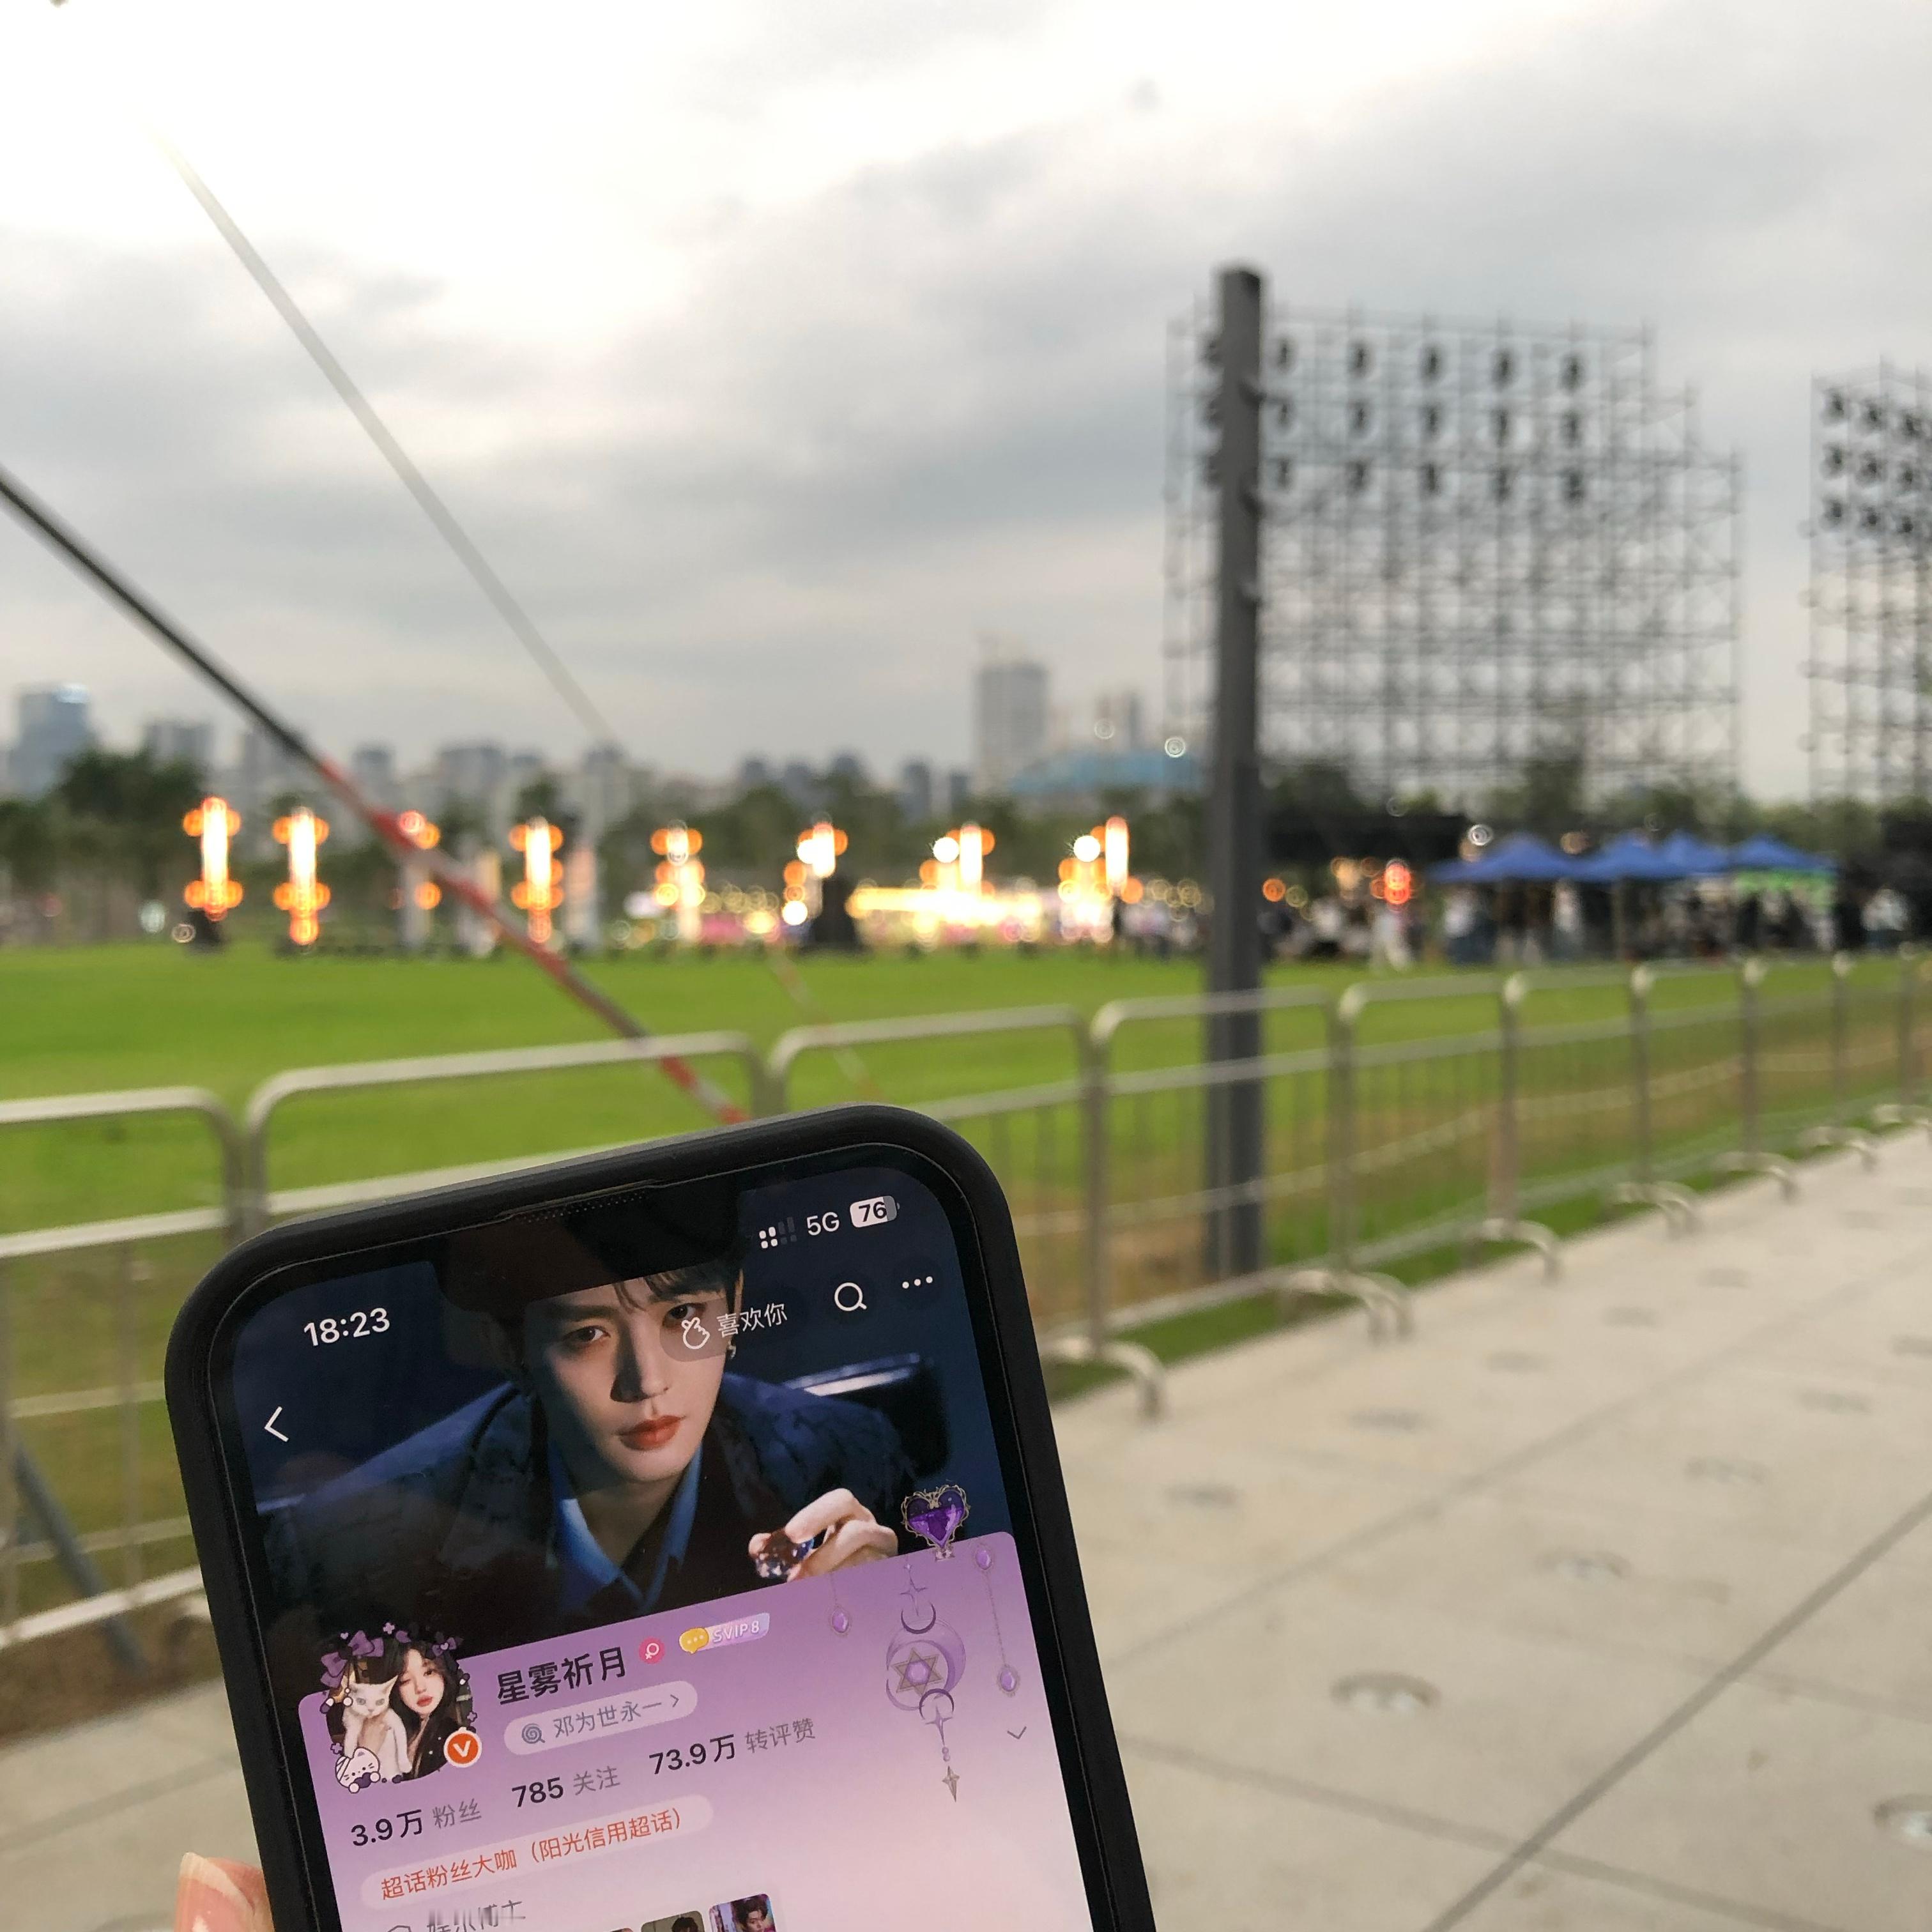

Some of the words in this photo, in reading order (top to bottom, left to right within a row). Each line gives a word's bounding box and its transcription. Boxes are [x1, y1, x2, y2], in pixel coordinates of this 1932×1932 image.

[806, 1211, 839, 1236] 5G
[859, 1201, 887, 1222] 76
[304, 1307, 390, 1346] 18:23
[716, 1303, 788, 1337] 喜欢你
[497, 1646, 626, 1705] 星雾祈月
[553, 1700, 662, 1738] 邓为世永一
[649, 1734, 736, 1775] 73.9万
[744, 1717, 816, 1754] 转评赞
[512, 1777, 564, 1807] 785
[572, 1765, 620, 1796] 关注
[351, 1809, 422, 1846] 3.9万
[432, 1798, 482, 1829] 粉丝
